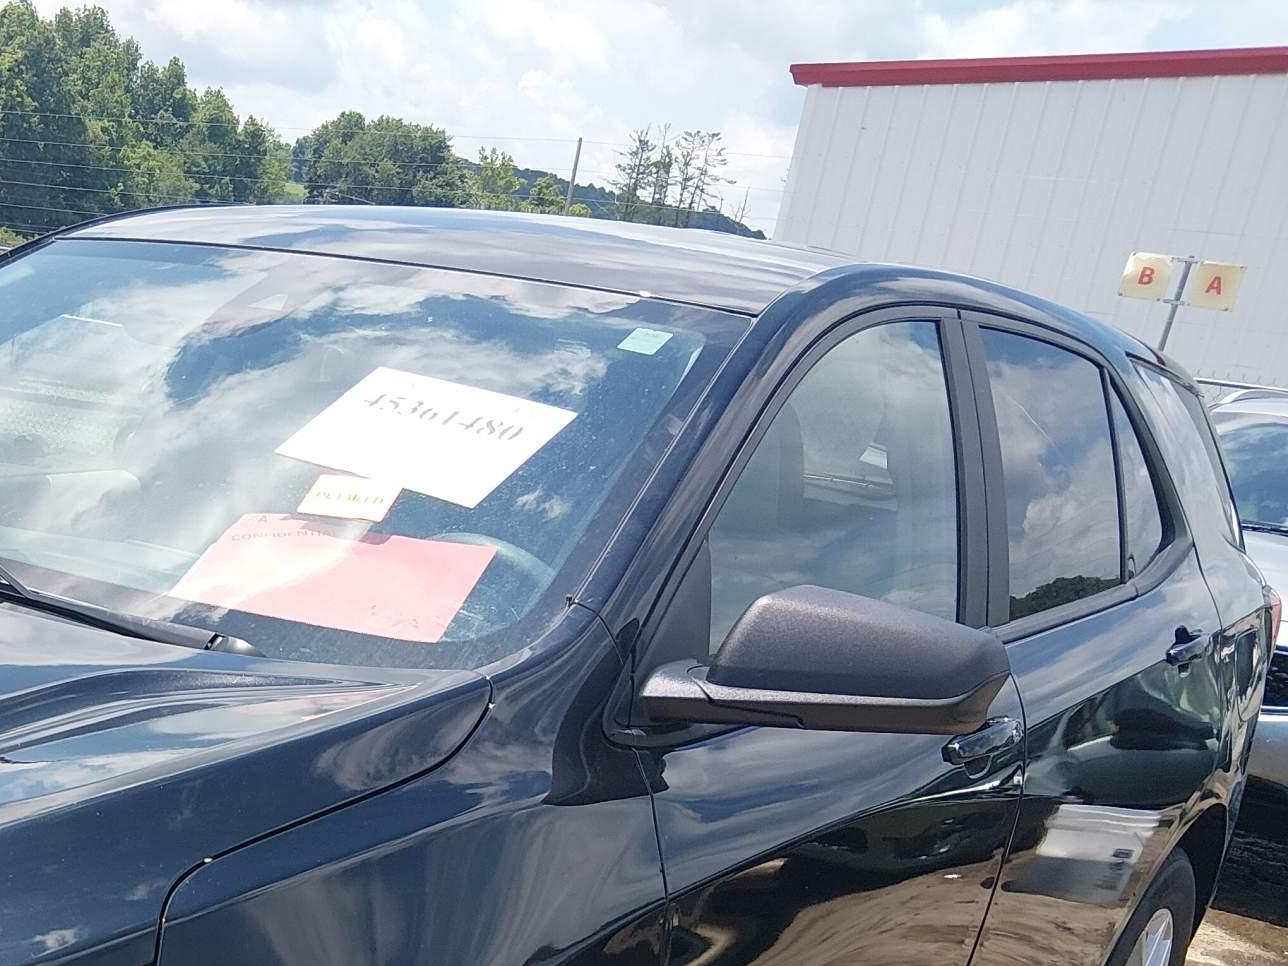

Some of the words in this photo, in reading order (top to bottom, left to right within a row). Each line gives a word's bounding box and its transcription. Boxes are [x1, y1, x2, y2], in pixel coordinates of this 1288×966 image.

[1137, 266, 1155, 285] B
[1205, 275, 1222, 295] A
[363, 393, 524, 440] 45361480
